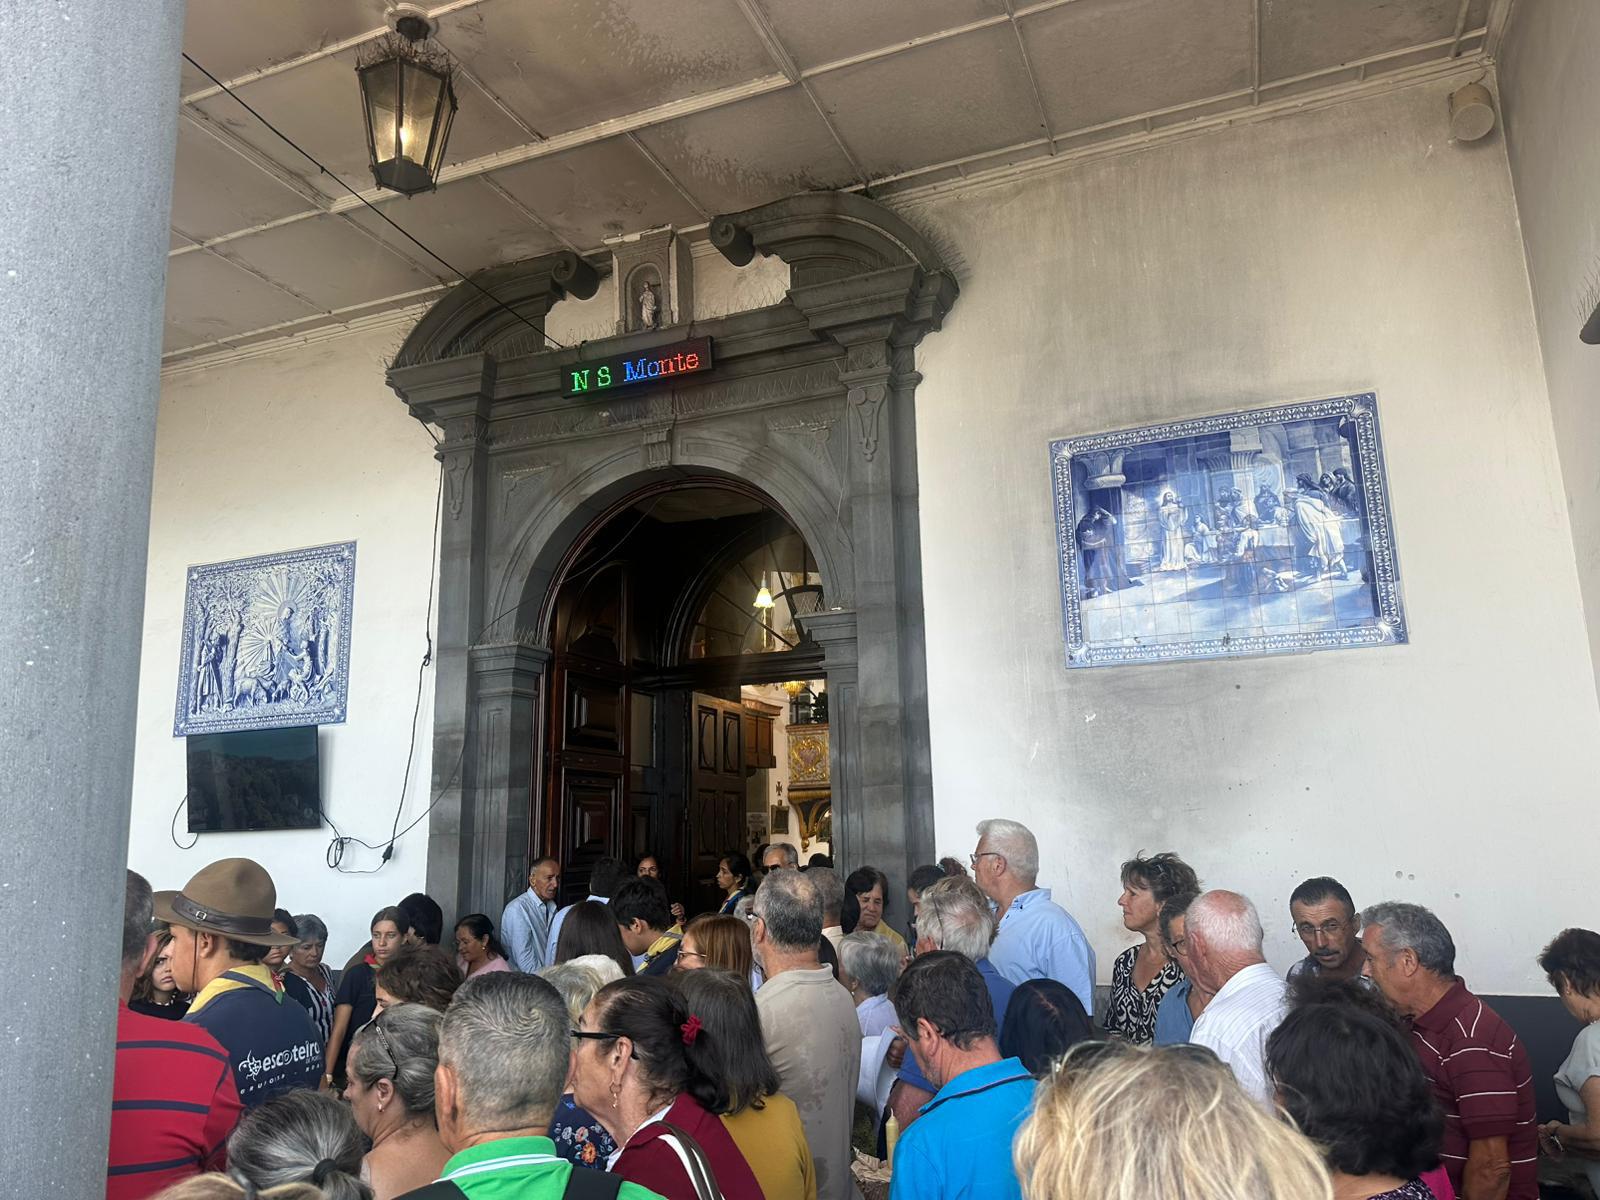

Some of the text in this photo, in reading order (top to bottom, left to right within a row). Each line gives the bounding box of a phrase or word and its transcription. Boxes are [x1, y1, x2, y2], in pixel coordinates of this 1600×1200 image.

[571, 353, 699, 392] N S Monte
